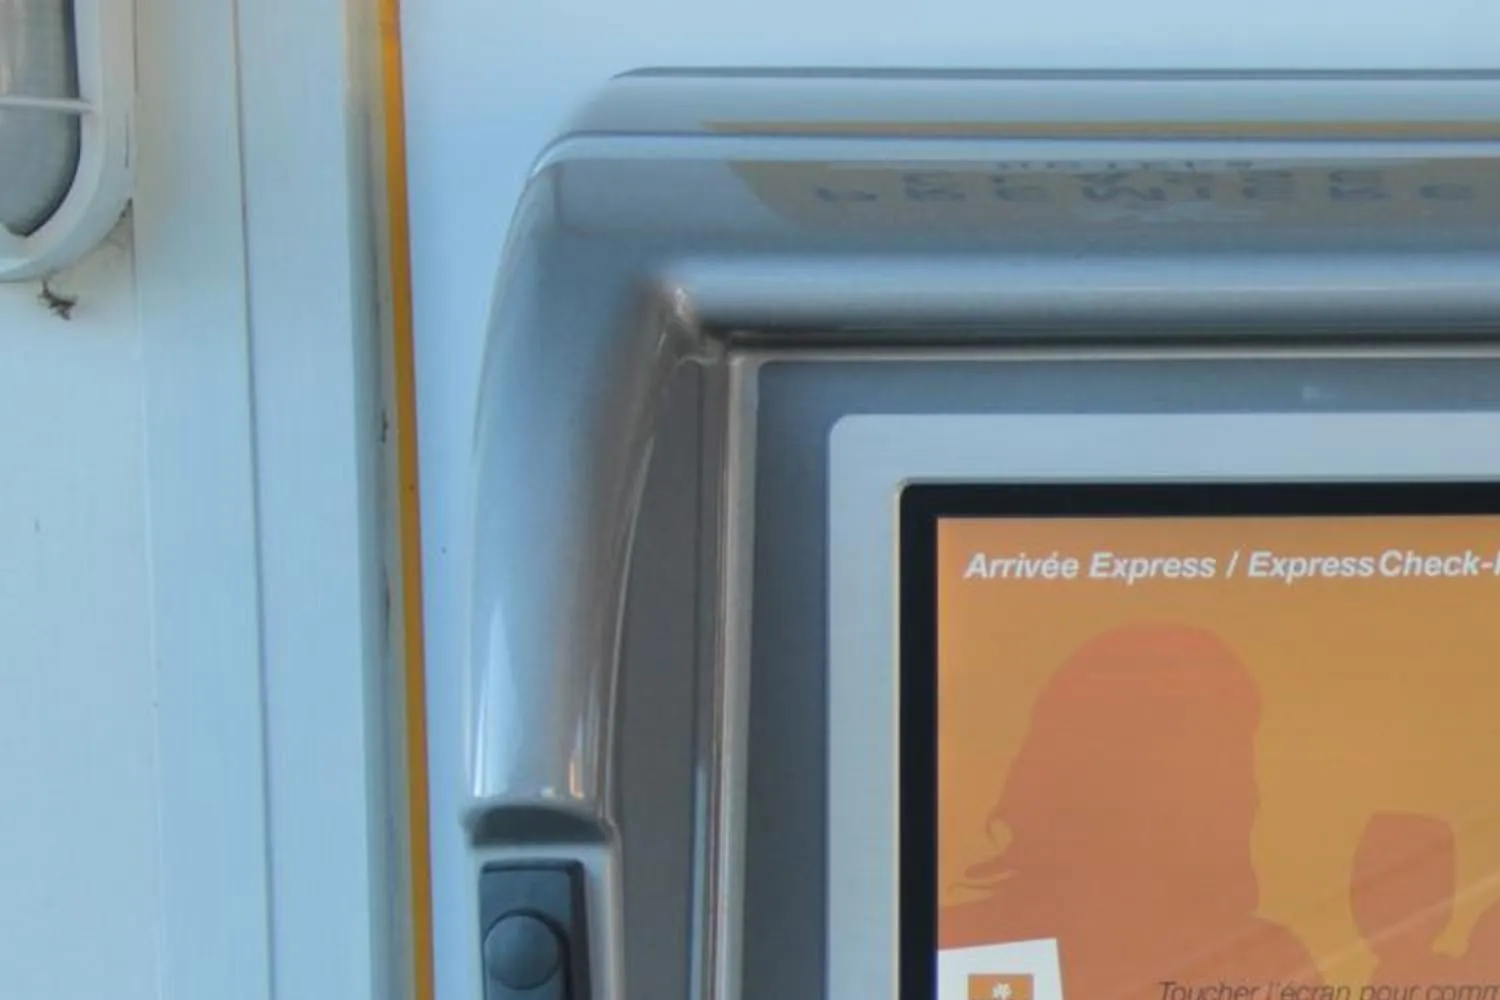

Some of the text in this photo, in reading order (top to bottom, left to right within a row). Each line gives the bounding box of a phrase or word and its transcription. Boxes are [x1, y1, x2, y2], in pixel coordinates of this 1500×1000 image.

[962, 551, 1081, 579] Arrivée
[1088, 551, 1217, 586] Express
[1225, 550, 1240, 579] /
